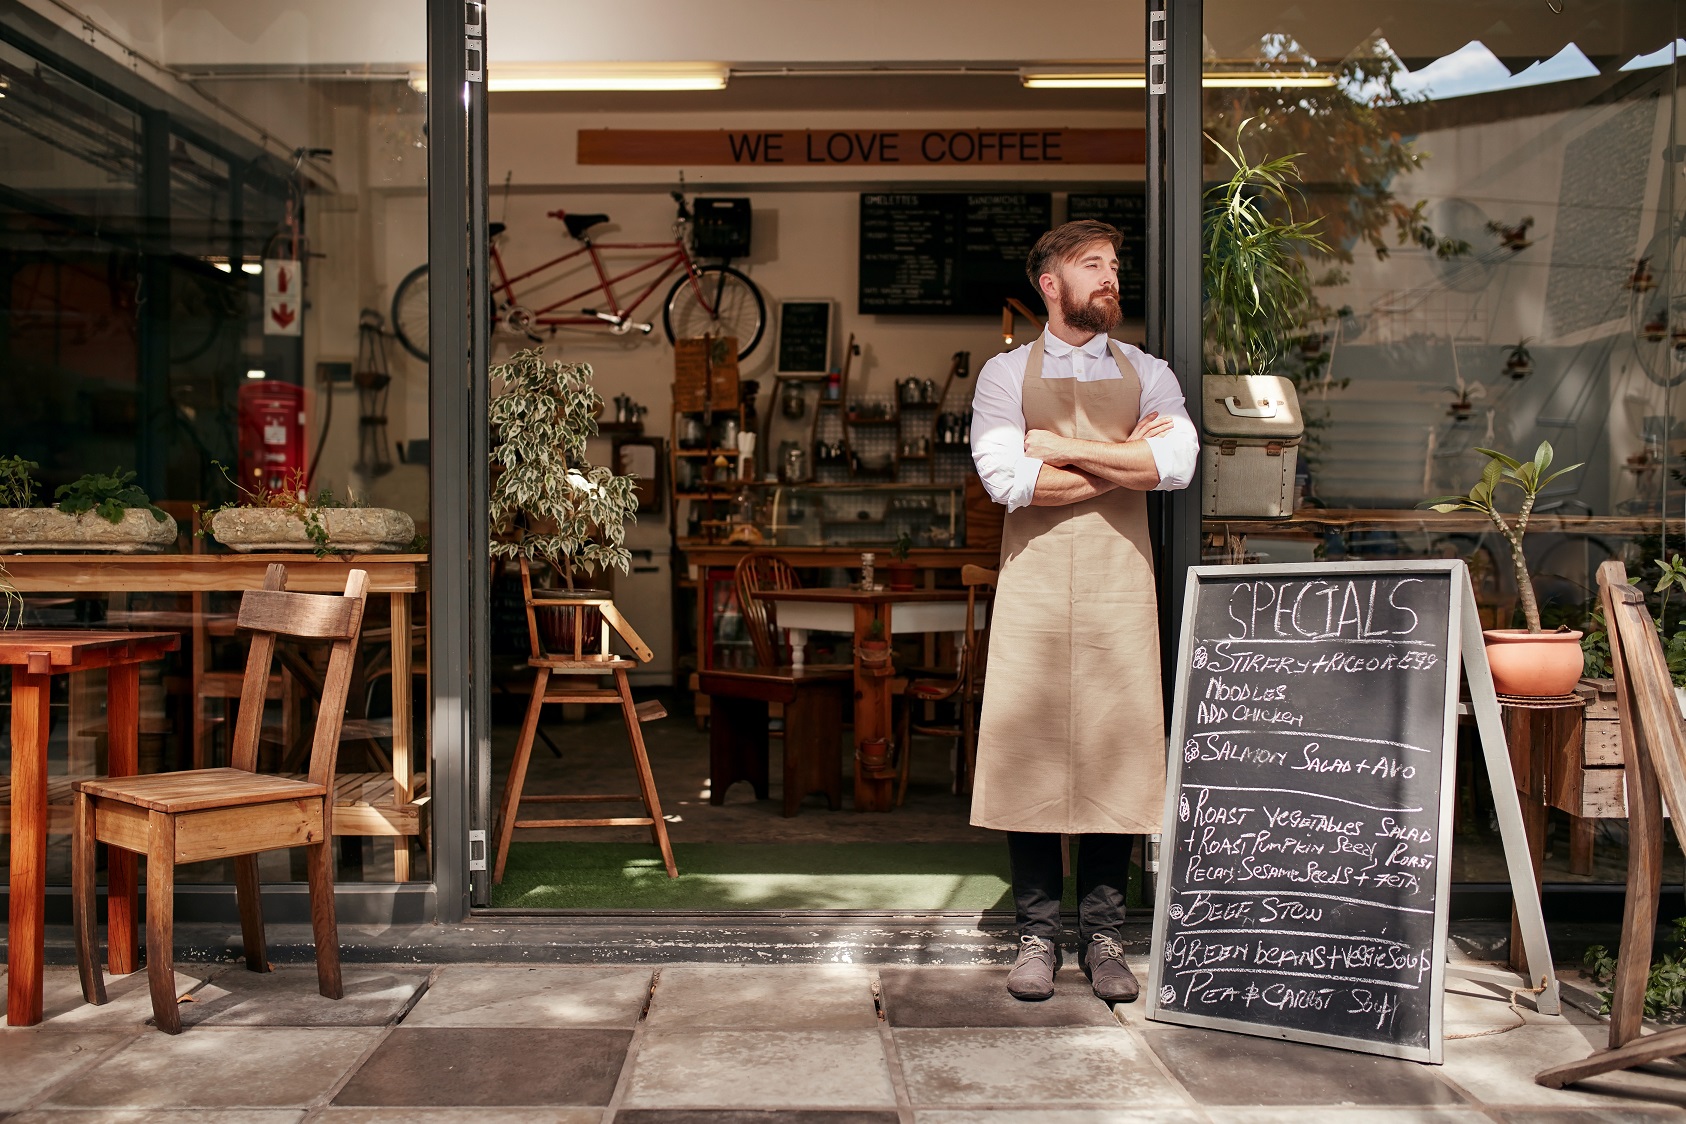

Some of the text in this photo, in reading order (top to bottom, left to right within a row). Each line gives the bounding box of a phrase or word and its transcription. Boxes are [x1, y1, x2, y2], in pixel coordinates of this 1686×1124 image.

[728, 132, 1062, 163] WE LOVE COFFEE
[1228, 578, 1424, 640] SPECIALS
[1205, 676, 1288, 702] NOODLES
[1197, 701, 1228, 725] ADD
[1201, 734, 1288, 766] SALMON
[1291, 743, 1352, 774] SALAD
[1194, 788, 1255, 828] ROAST
[1375, 817, 1432, 844] SALAD
[1201, 826, 1257, 856] ROAST
[1181, 892, 1254, 927] BEEF
[1183, 972, 1241, 1007] PEA
